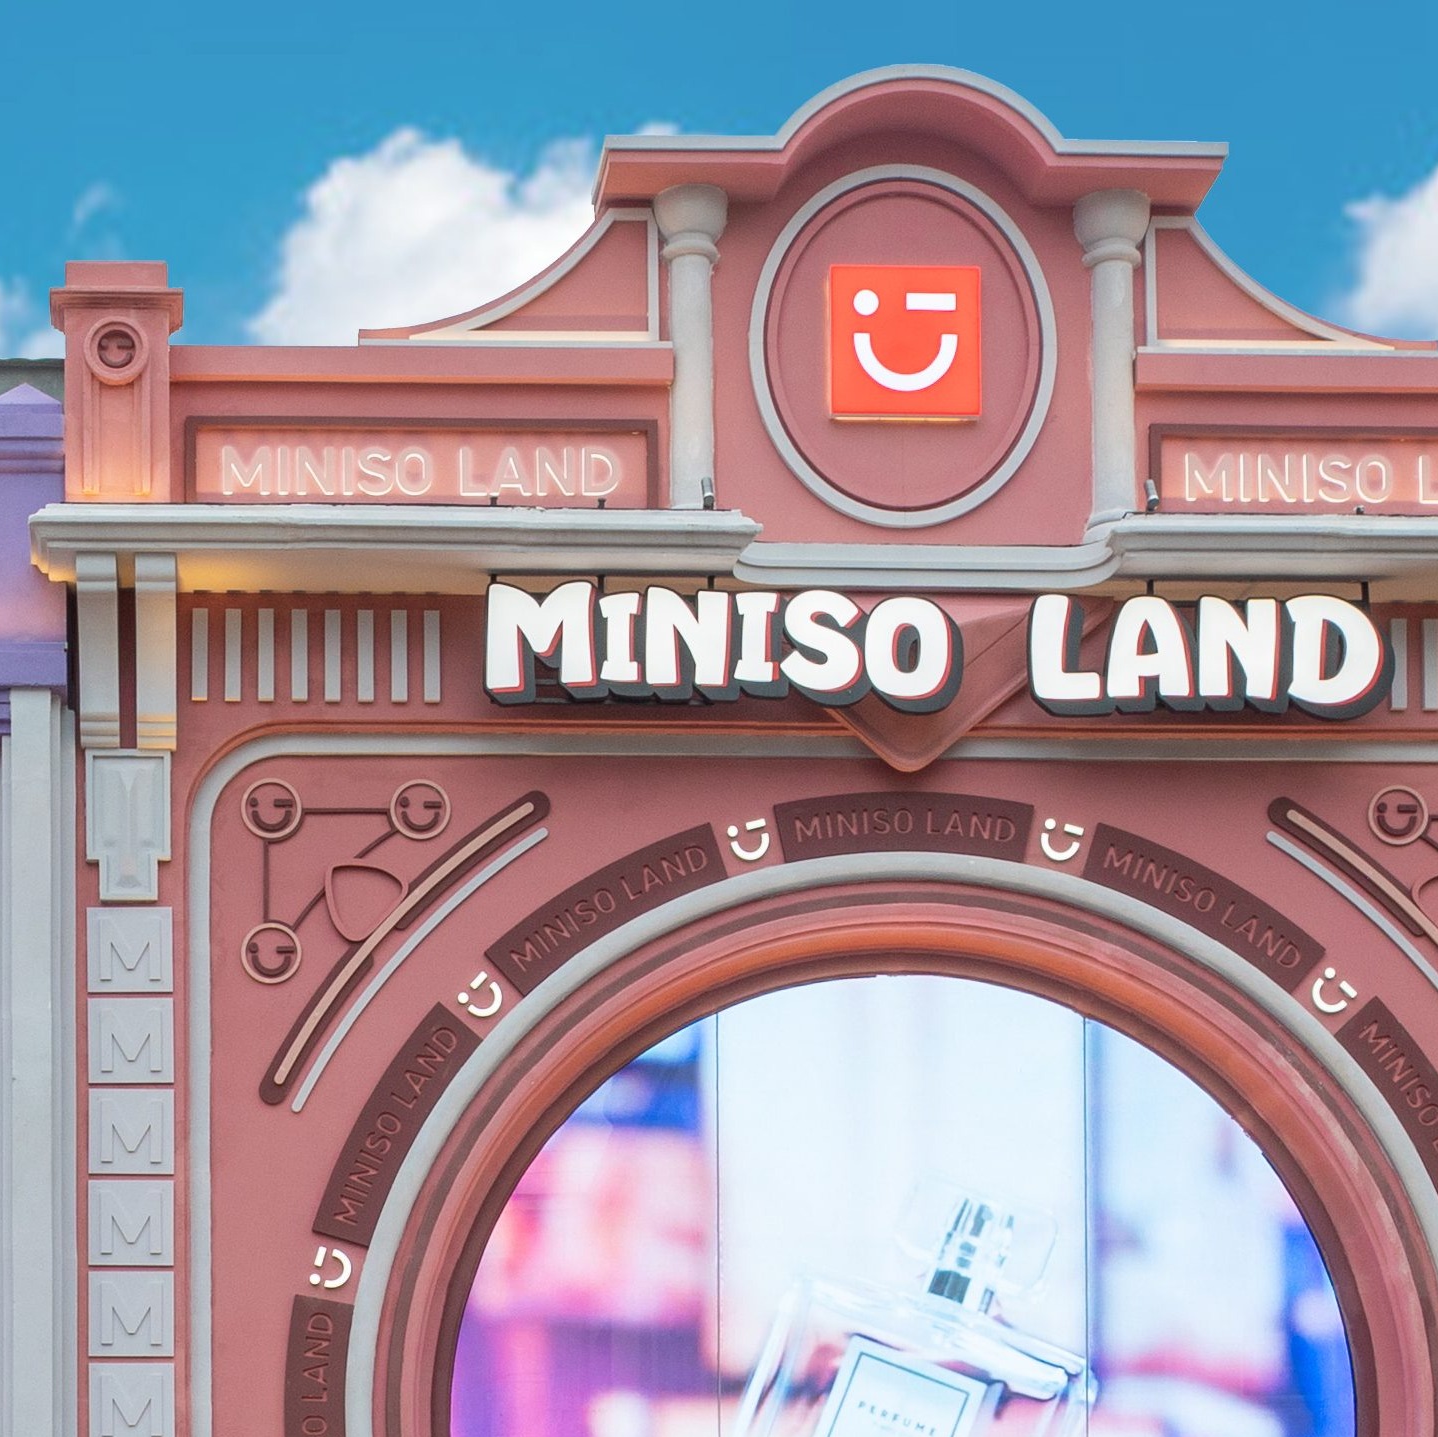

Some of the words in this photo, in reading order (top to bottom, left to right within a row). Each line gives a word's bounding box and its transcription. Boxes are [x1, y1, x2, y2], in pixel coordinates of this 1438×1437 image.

[220, 444, 434, 498] MINISO
[456, 445, 622, 499] LAND
[1181, 452, 1390, 505] MINISO
[483, 576, 964, 714] MINISO
[1029, 587, 1394, 720] LAND
[794, 802, 914, 842] MINISO
[925, 808, 1016, 844] LAND
[508, 889, 617, 972] MINISO
[622, 844, 710, 903] LAND
[1103, 844, 1217, 913] MINISO
[1222, 898, 1303, 971] LAND
[857, 1400, 938, 1437] PERFUME
